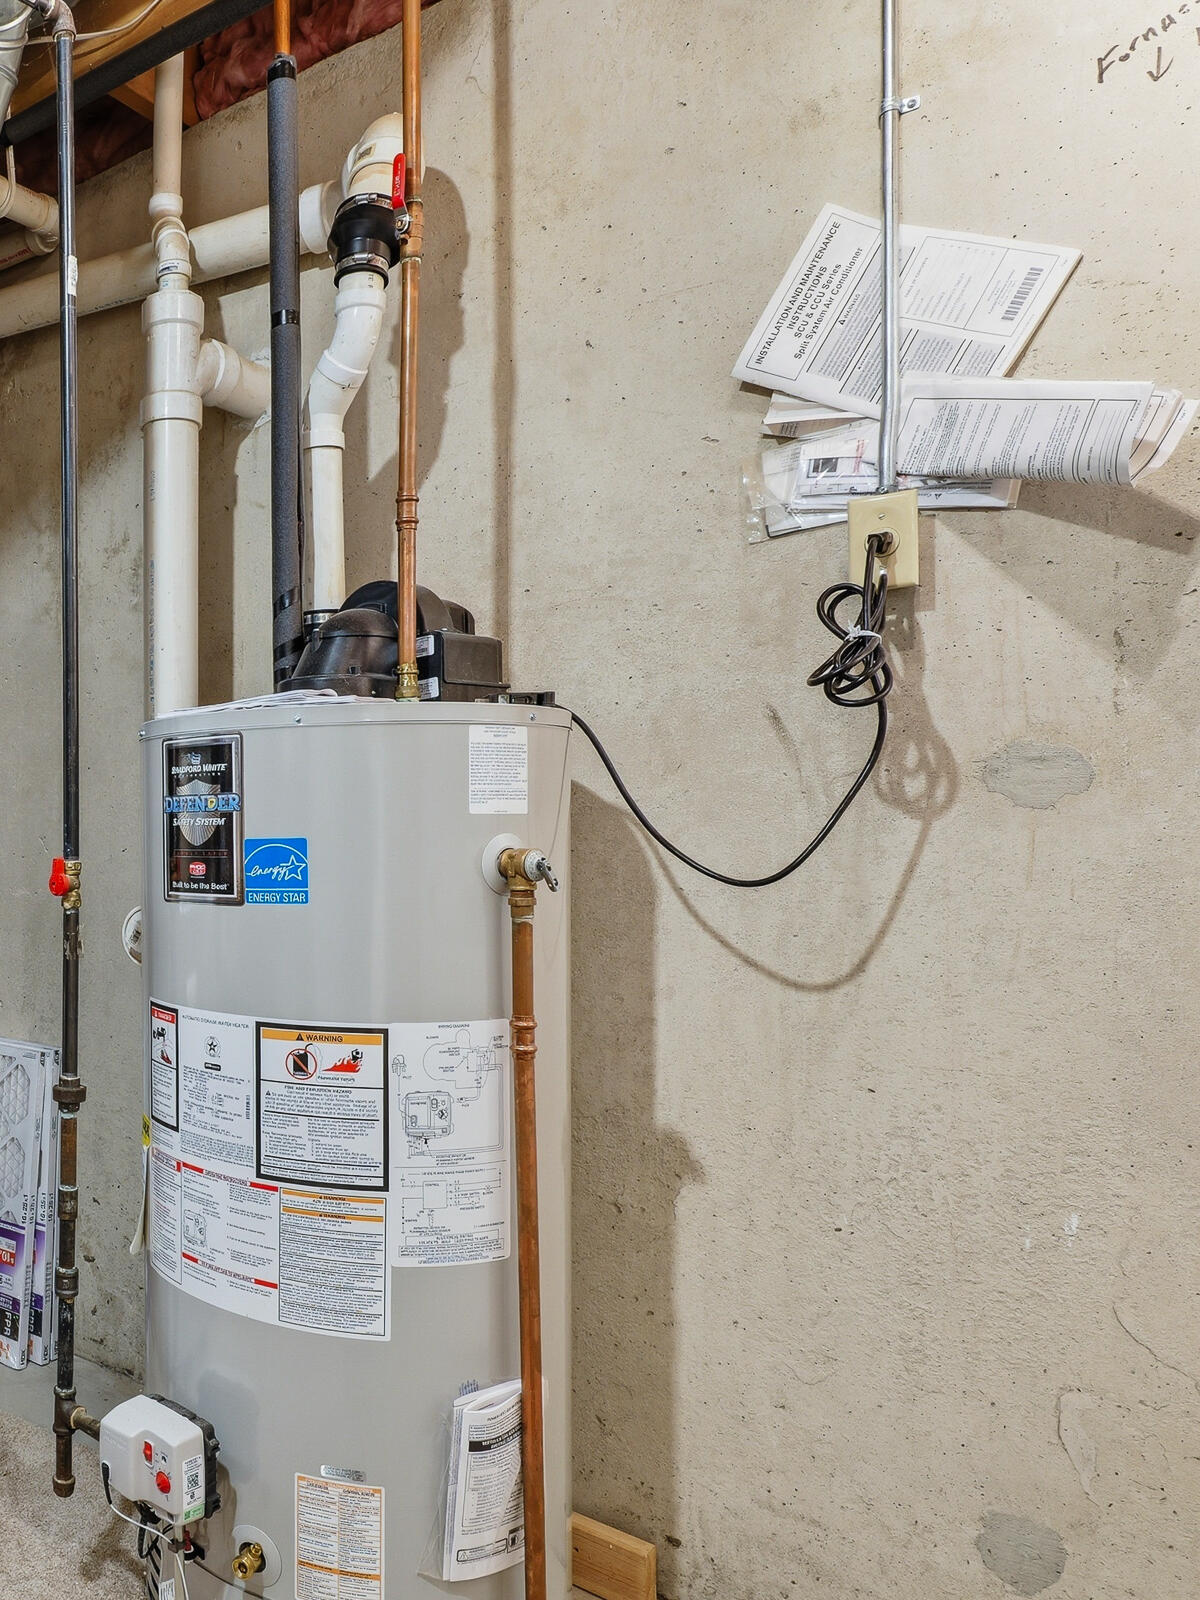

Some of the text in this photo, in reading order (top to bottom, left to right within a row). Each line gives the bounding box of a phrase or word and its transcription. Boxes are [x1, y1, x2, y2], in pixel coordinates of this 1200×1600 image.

[754, 221, 841, 366] INSTALLATION AND MAINTENANCE
[786, 265, 828, 330] INSTRUCTIONS
[794, 262, 842, 339] SCU & CCU Series
[794, 247, 863, 361] Split System Air Conditioner
[202, 762, 227, 772] WHITE
[164, 793, 241, 813] DEFENDER
[248, 892, 306, 902] ENERGY STAR
[306, 1034, 343, 1043] WARNING
[3, 1311, 11, 1336] FPR
